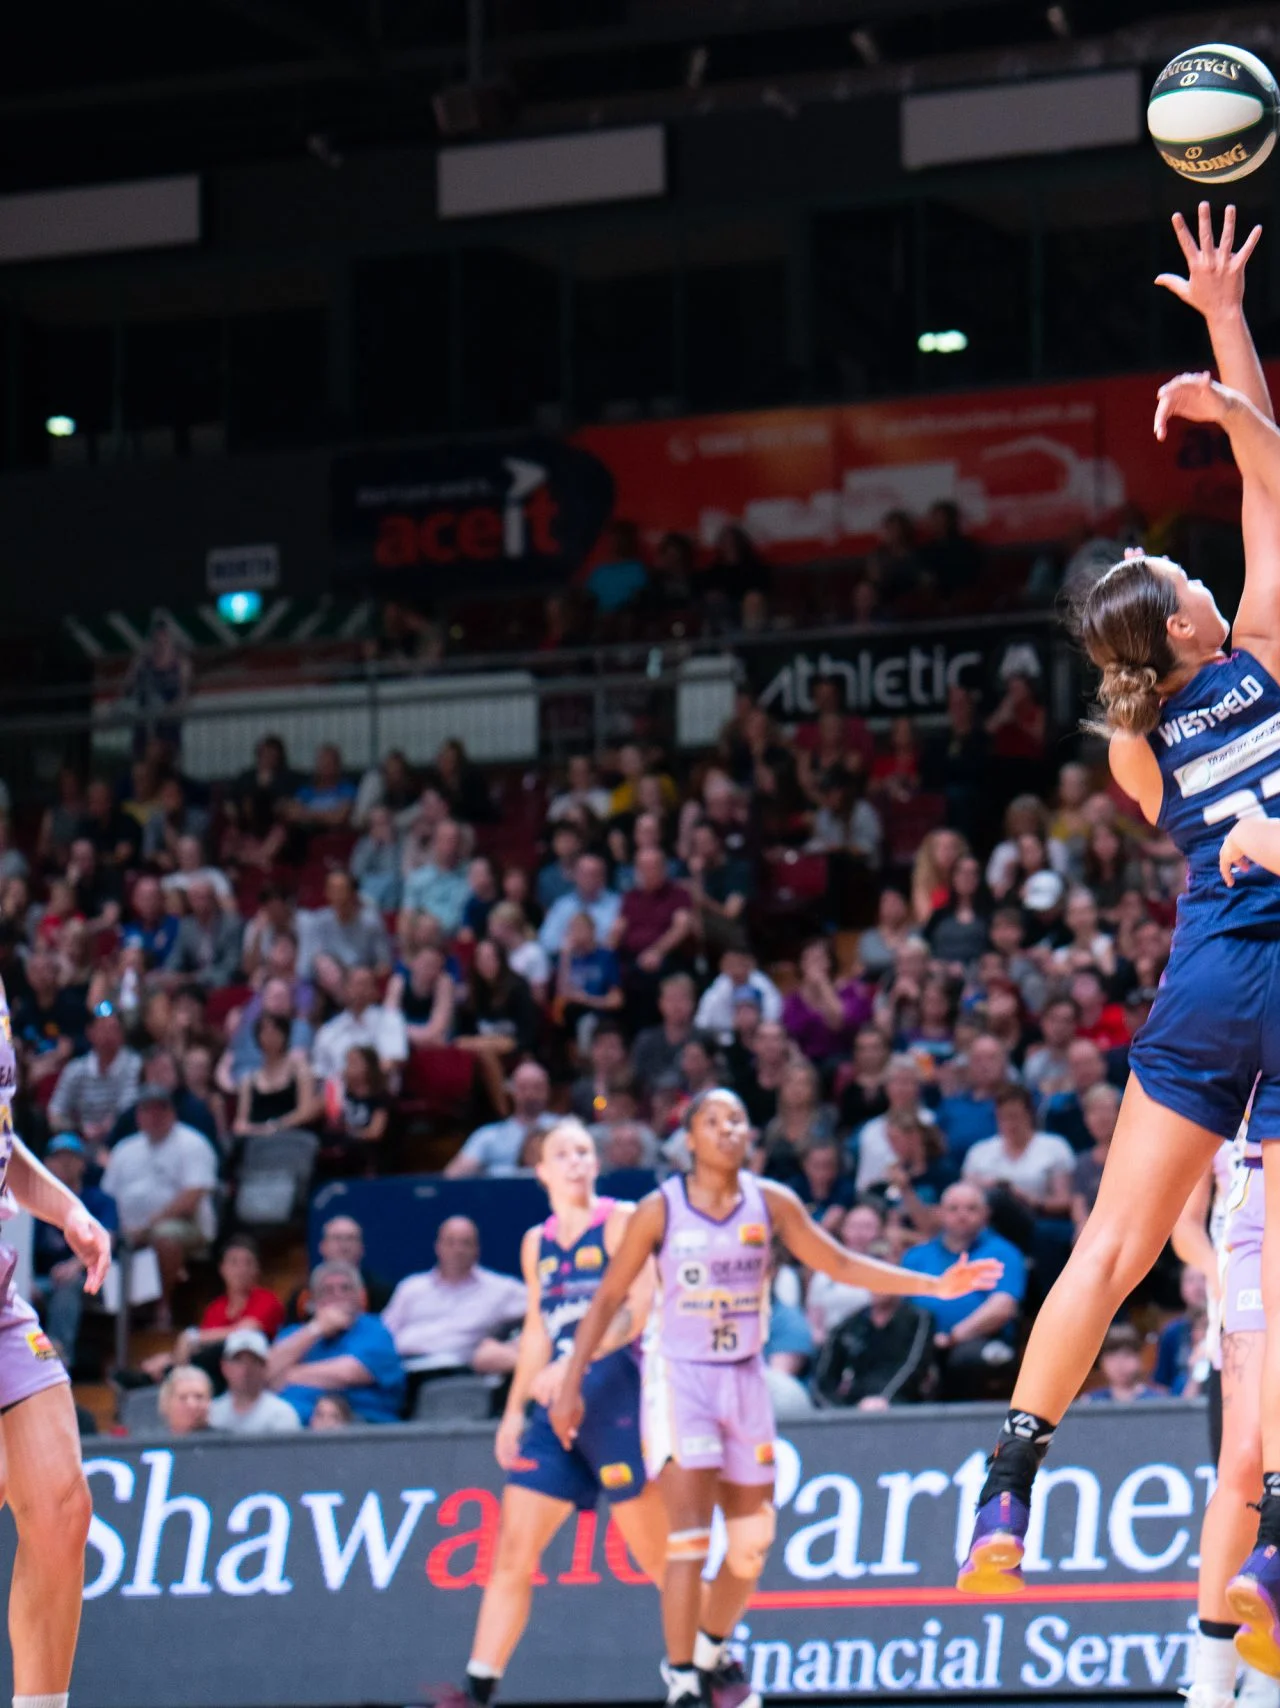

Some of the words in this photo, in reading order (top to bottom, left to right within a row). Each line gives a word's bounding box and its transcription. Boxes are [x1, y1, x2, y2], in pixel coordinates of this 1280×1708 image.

[373, 456, 563, 566] aceit
[1158, 674, 1264, 748] WESTBELD
[711, 1324, 738, 1352] 15
[727, 1615, 1003, 1692] inancial
